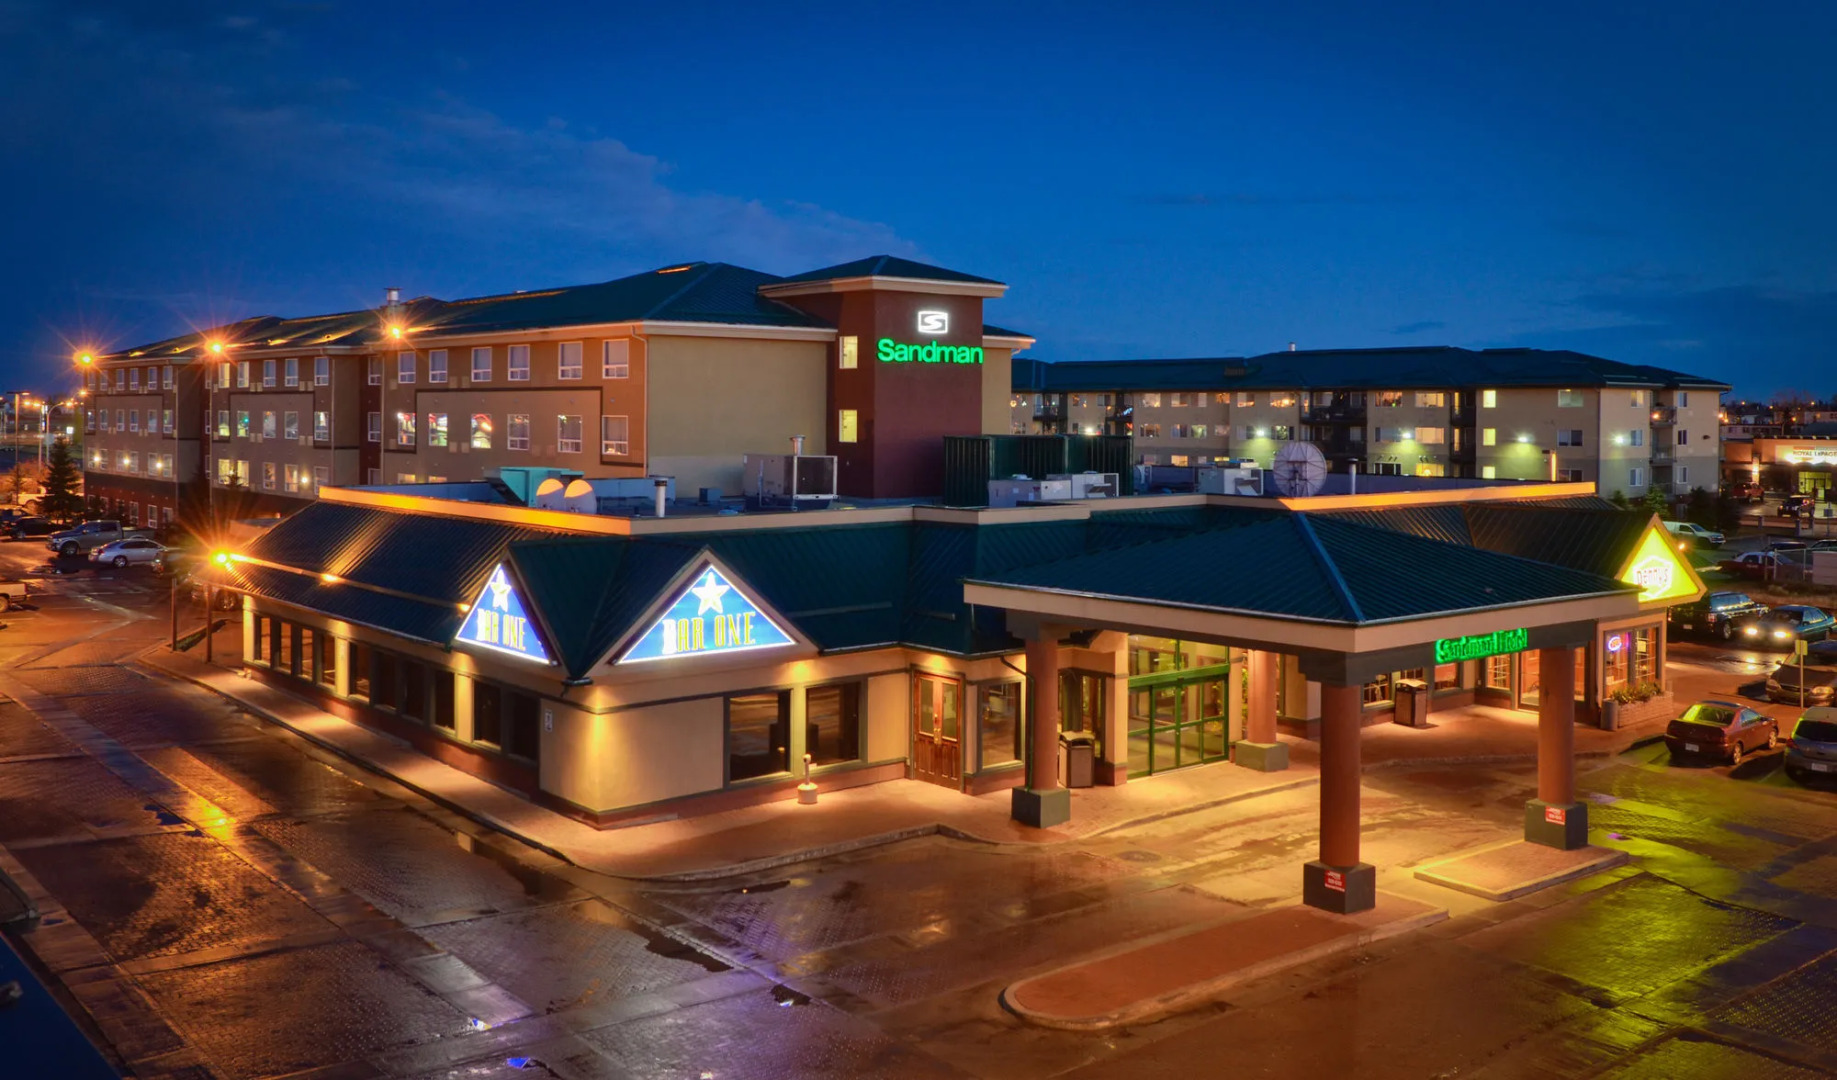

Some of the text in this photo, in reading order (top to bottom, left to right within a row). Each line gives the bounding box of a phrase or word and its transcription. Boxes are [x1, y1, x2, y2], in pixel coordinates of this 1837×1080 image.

[877, 338, 984, 364] Sandman
[503, 614, 526, 651] ONE
[714, 611, 756, 647] ONE
